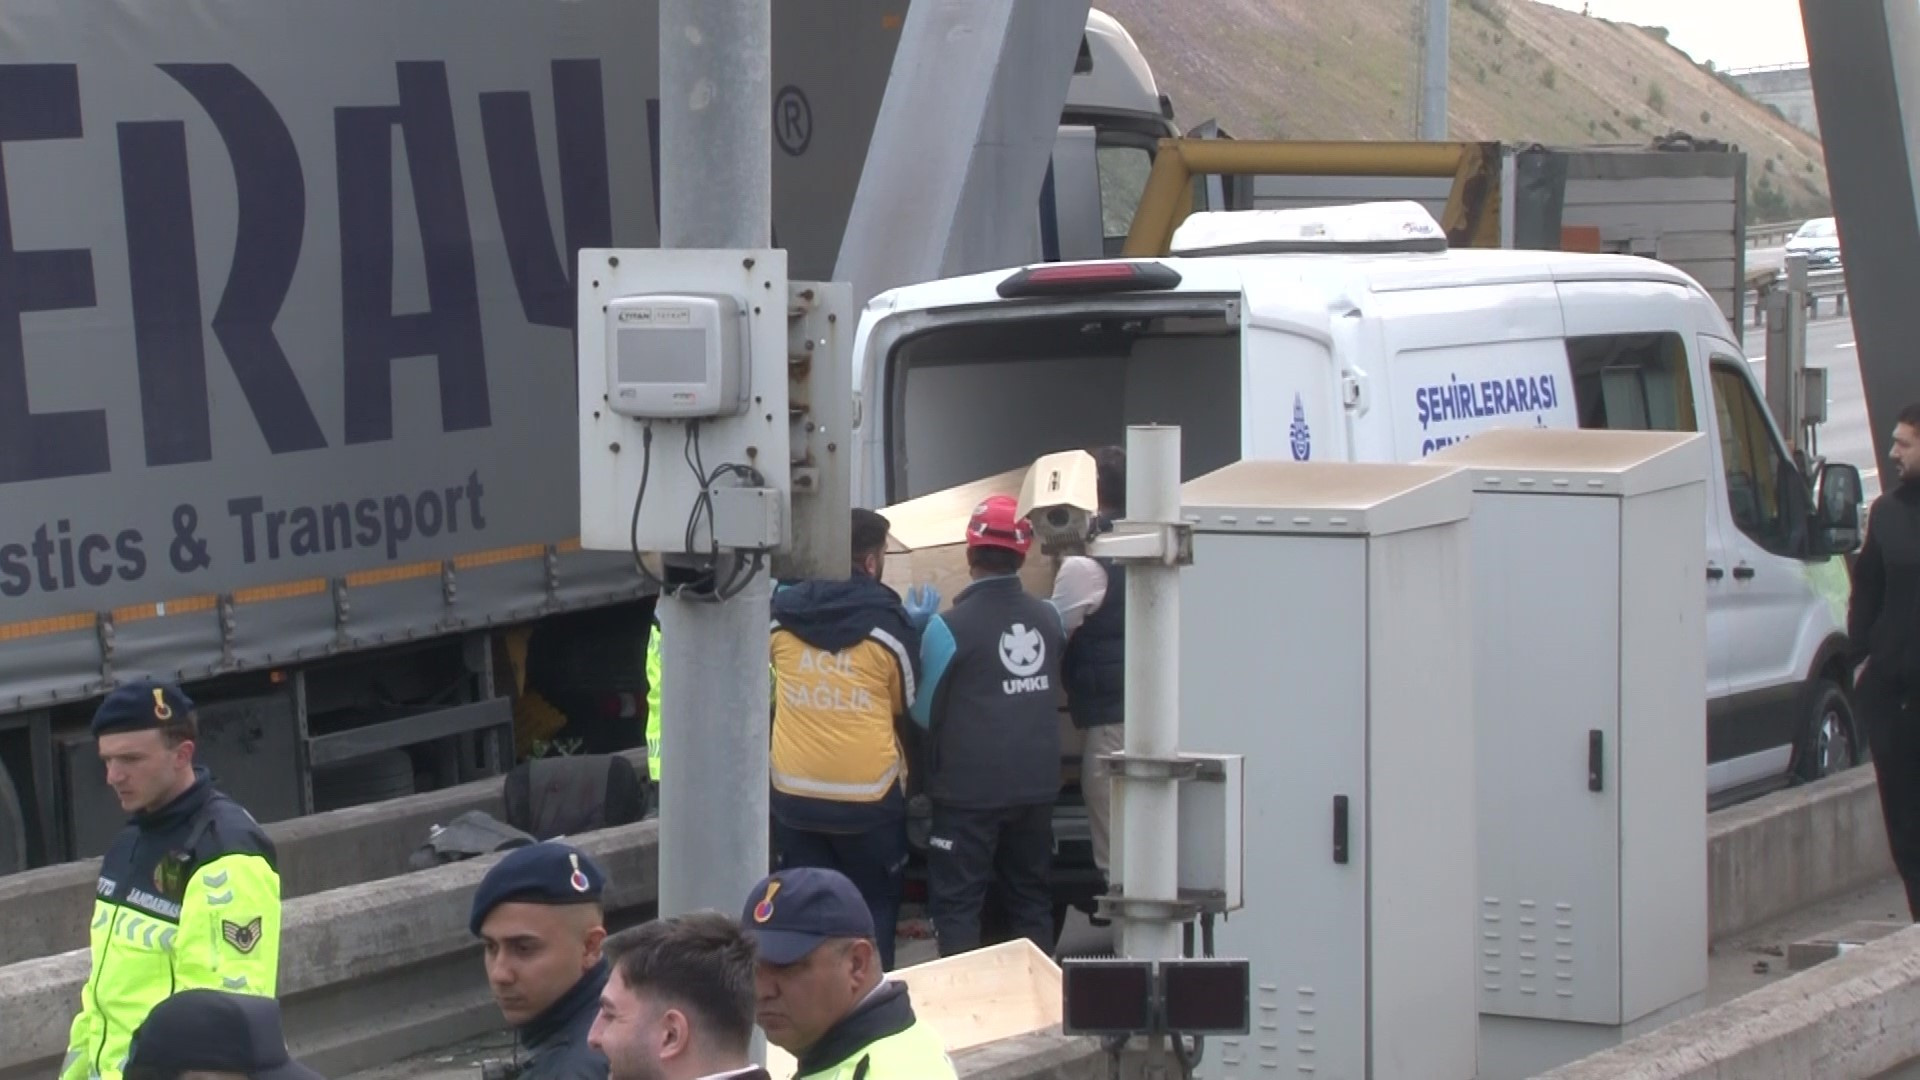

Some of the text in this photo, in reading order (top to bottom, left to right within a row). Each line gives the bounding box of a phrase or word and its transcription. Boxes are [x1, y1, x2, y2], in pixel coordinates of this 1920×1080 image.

[1416, 373, 1558, 430] ŞEHİRLERARASI
[0, 469, 487, 597] stics & Transport
[1002, 675, 1048, 695] UMKE
